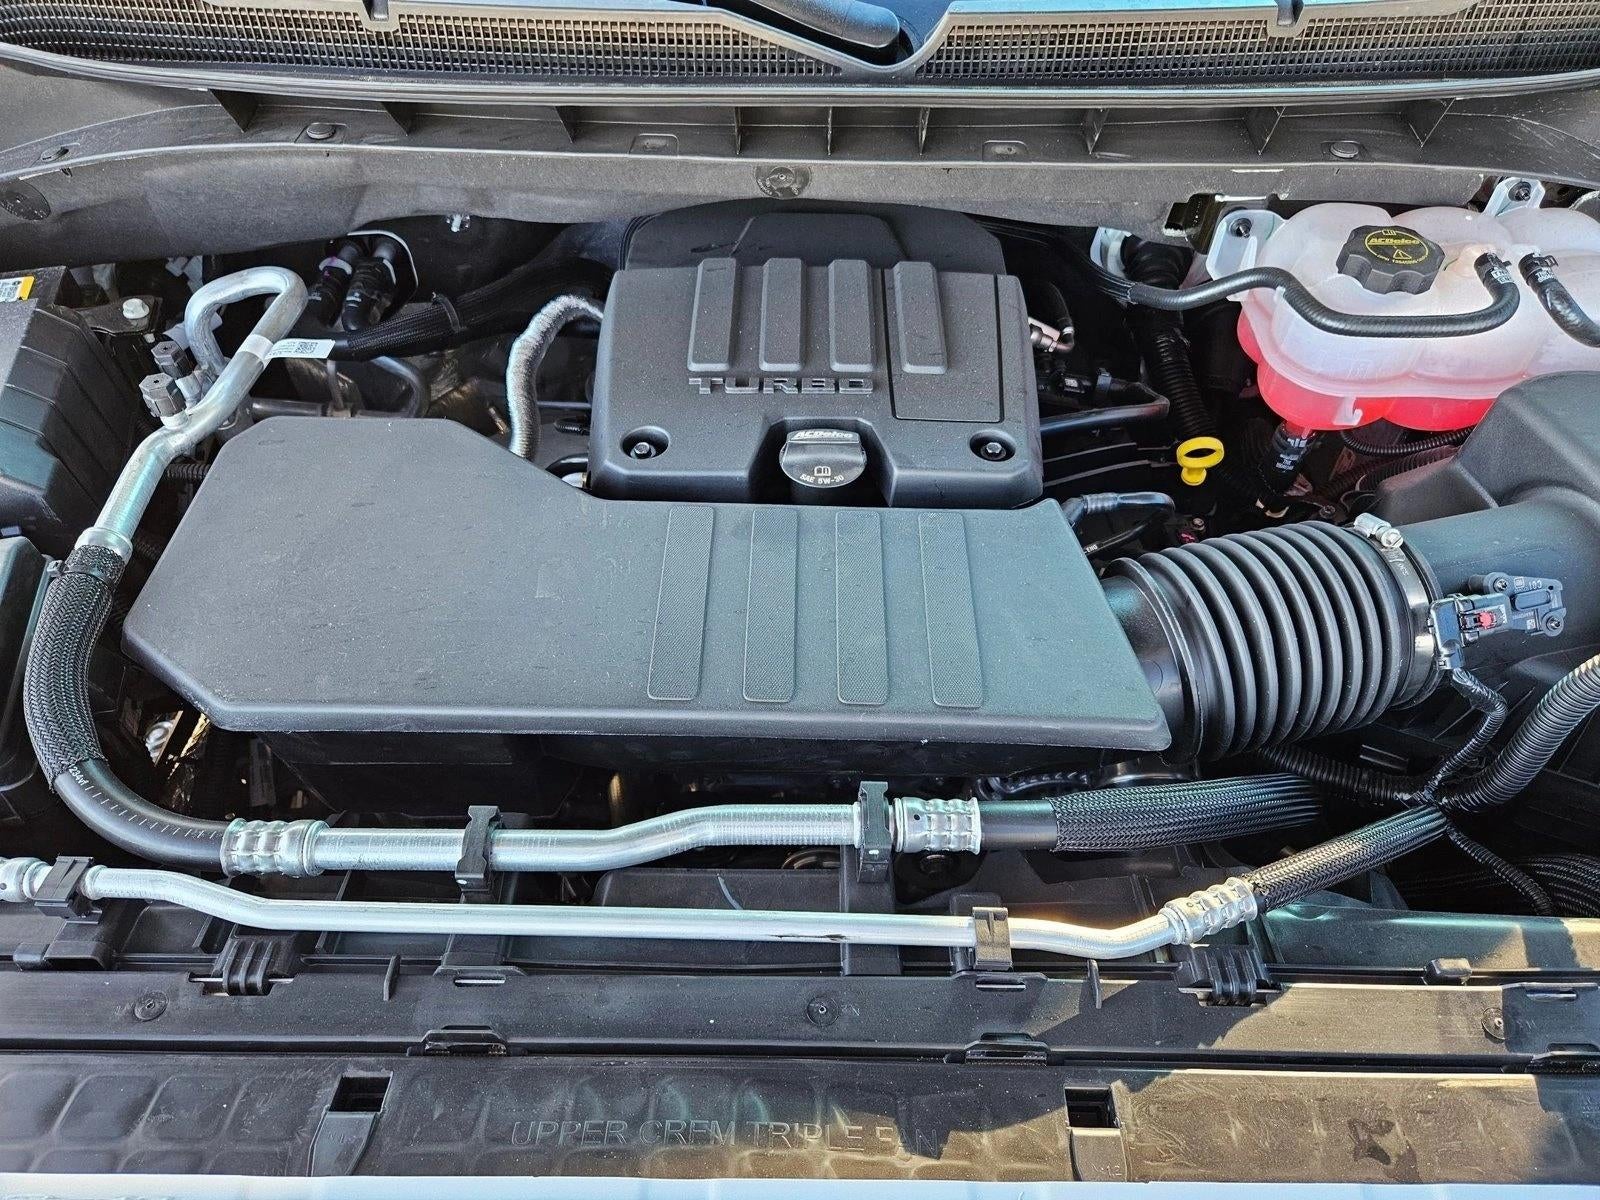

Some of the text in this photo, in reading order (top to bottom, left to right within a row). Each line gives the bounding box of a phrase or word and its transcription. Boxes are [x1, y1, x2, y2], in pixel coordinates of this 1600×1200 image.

[1368, 236, 1420, 246] ACDelco
[688, 378, 874, 395] TURBO
[793, 430, 854, 441] ACDelco
[800, 474, 845, 485] SAE 5W-30
[510, 1119, 629, 1147] UPPER
[746, 1120, 865, 1151] TRIPLE
